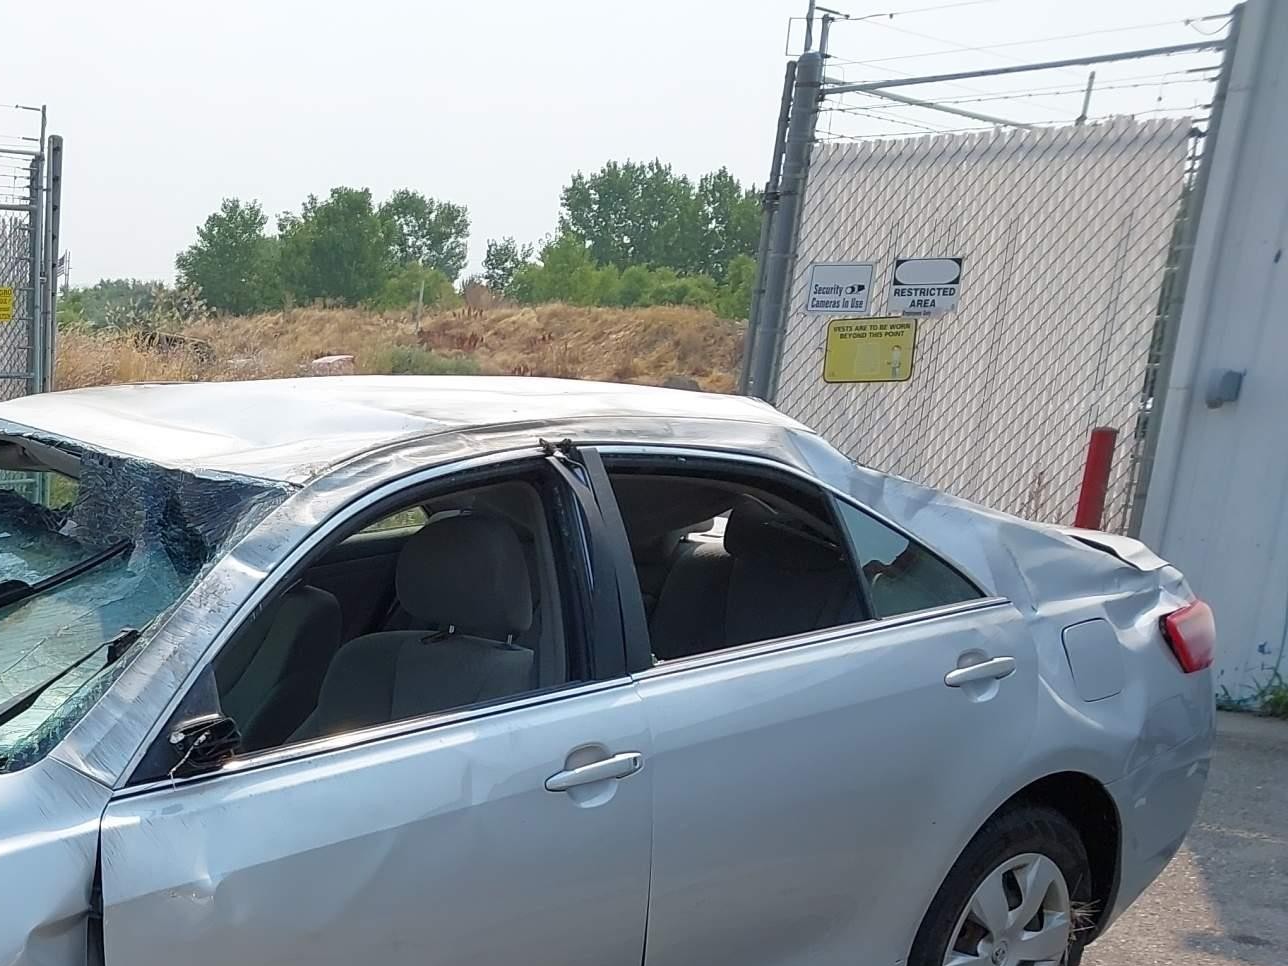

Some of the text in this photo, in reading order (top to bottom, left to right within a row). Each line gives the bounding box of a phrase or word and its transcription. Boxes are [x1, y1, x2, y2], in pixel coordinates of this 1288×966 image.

[814, 284, 844, 297] Security
[893, 287, 956, 297] RESTRICTED
[811, 297, 864, 309] Cameras In Use
[909, 299, 936, 309] AREA
